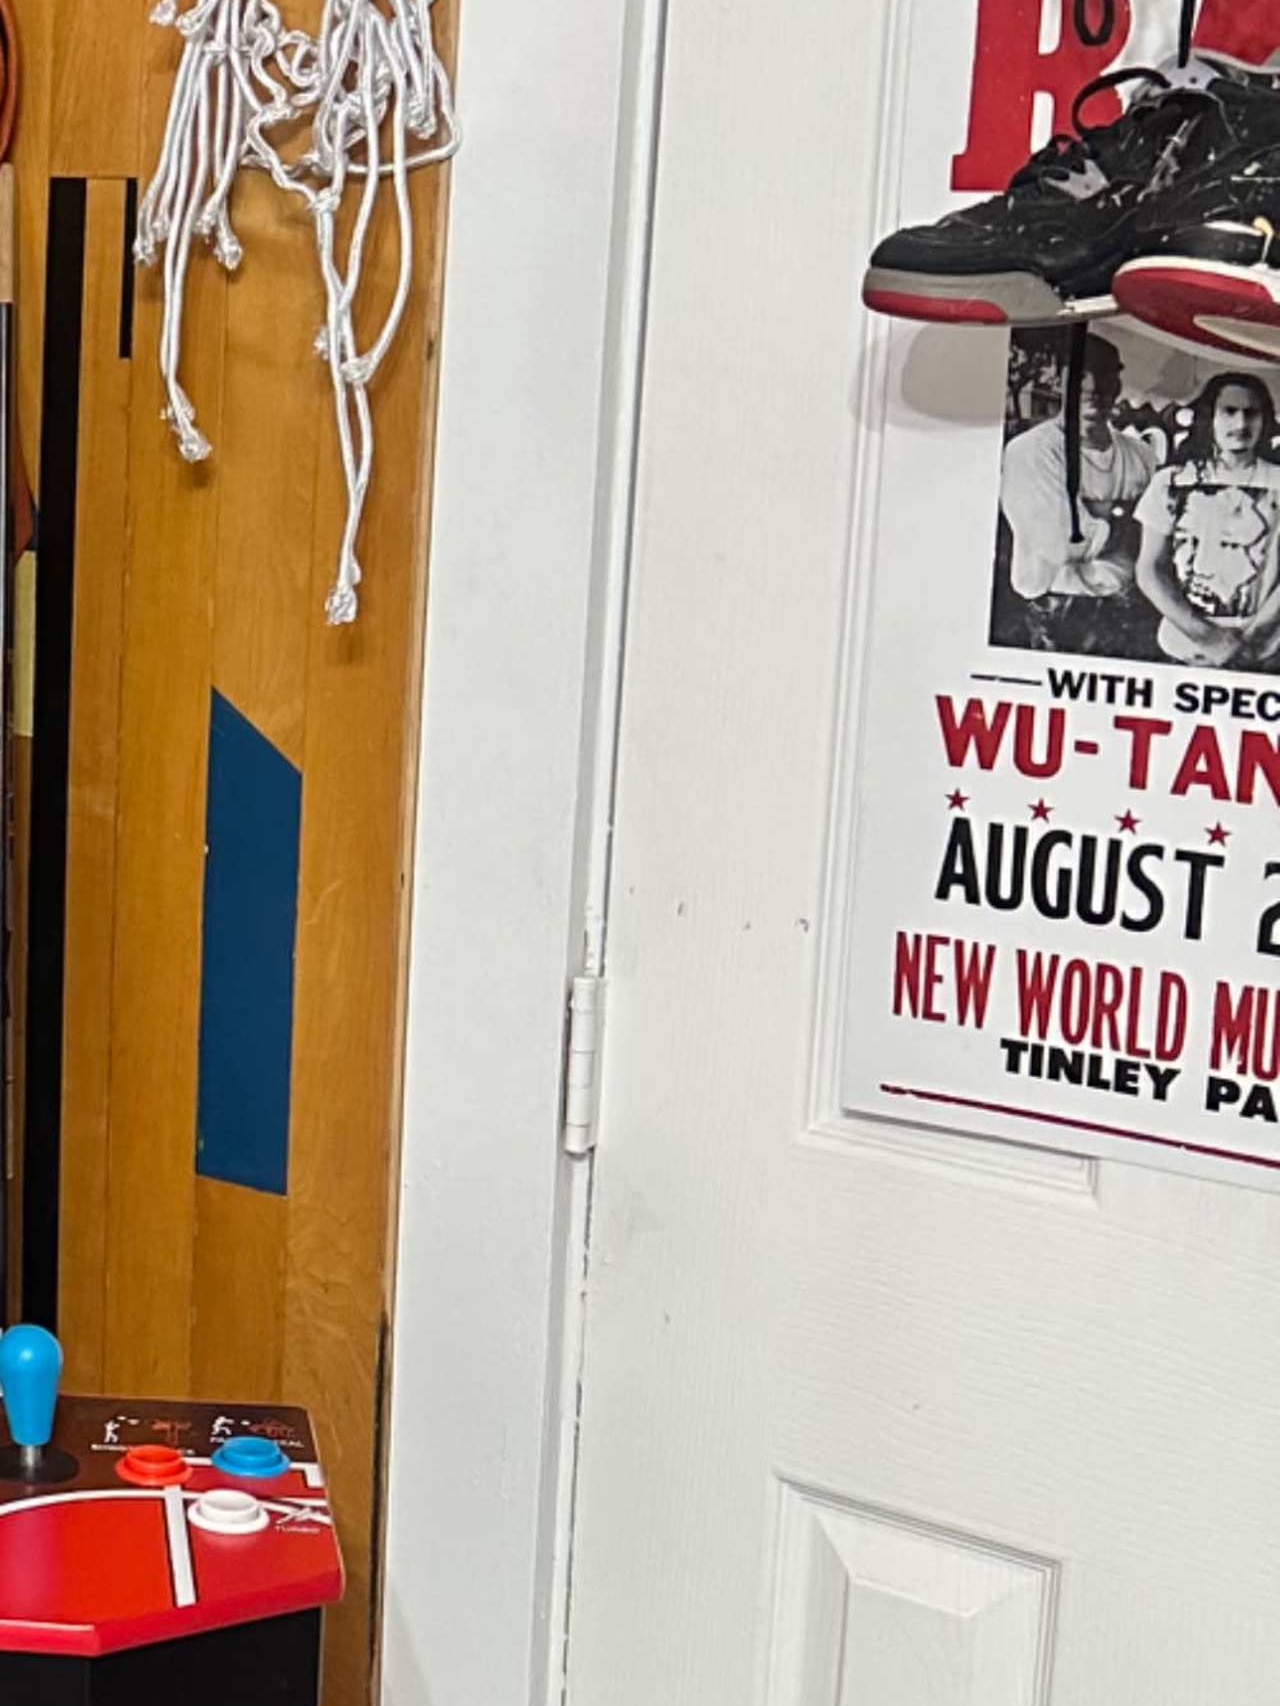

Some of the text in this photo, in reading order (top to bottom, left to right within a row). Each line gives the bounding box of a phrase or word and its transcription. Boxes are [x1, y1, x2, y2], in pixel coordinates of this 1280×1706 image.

[1048, 669, 1153, 709] WITH
[935, 817, 1224, 940] AUGUST
[893, 930, 996, 1030] NEW
[1016, 949, 1187, 1062] WORLD
[1000, 1038, 1181, 1101] TINLEY
